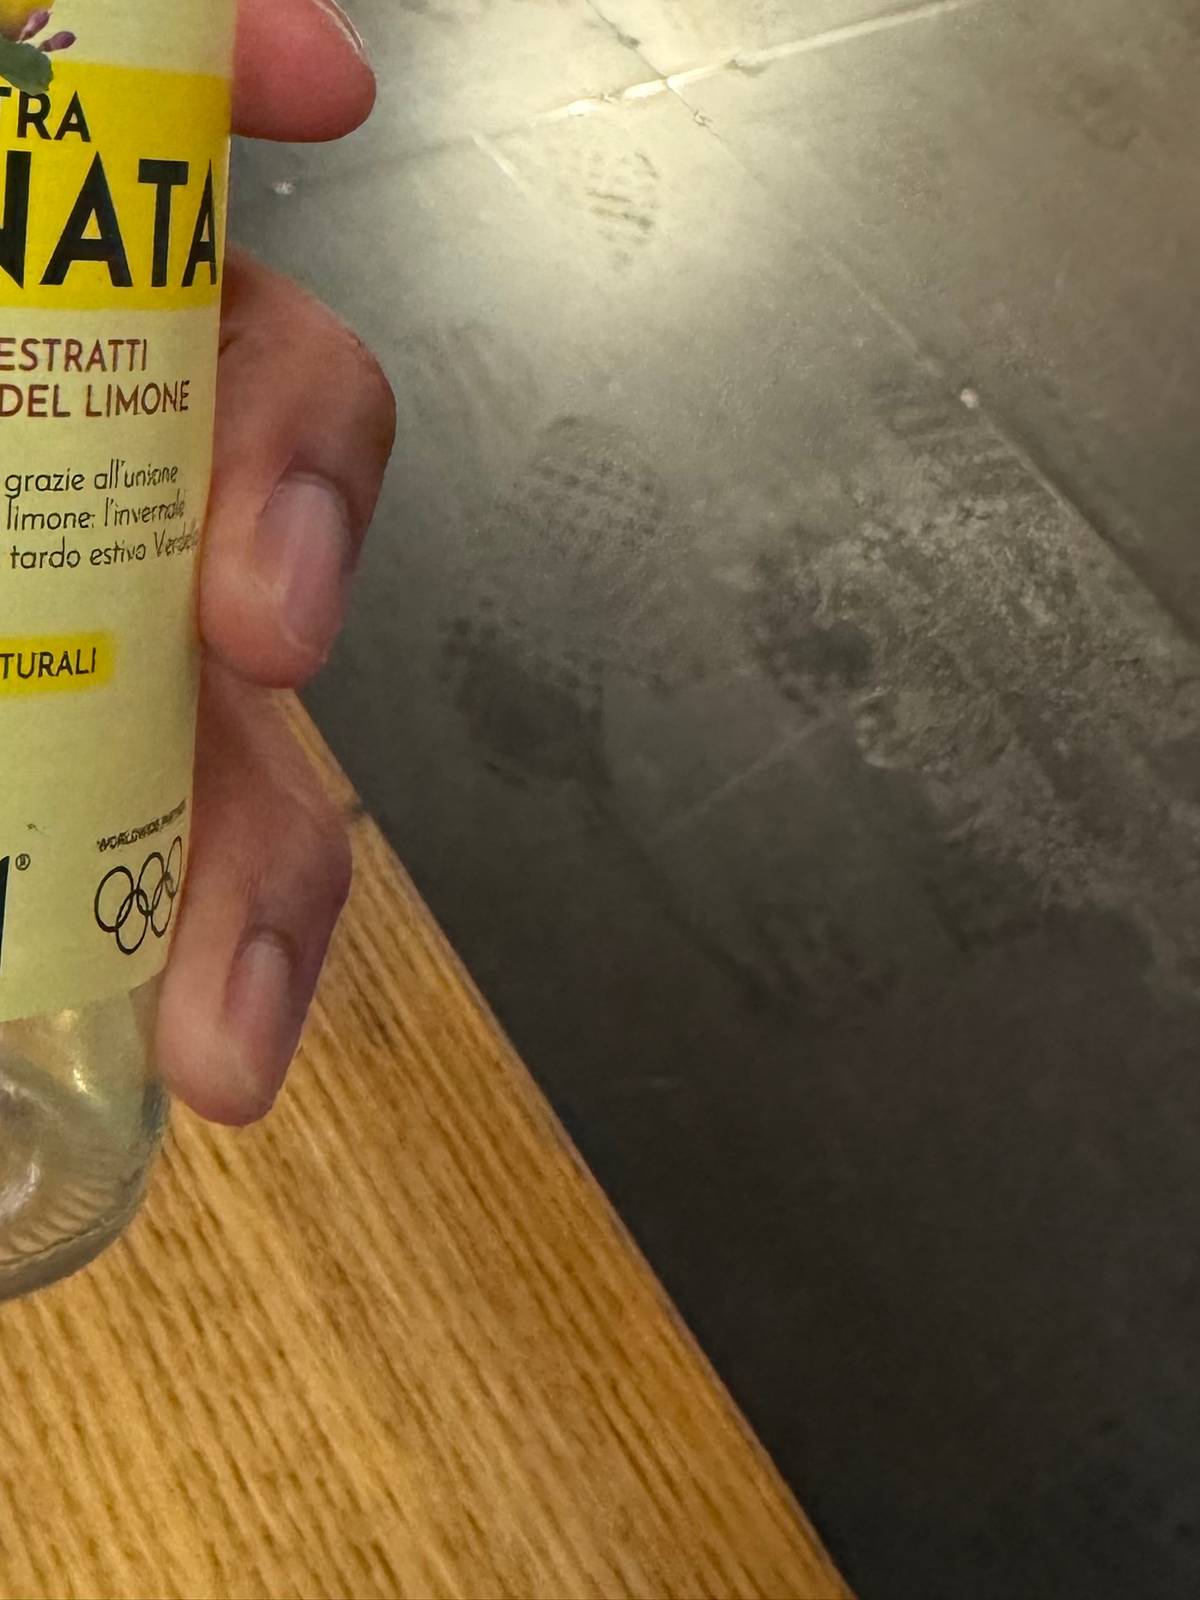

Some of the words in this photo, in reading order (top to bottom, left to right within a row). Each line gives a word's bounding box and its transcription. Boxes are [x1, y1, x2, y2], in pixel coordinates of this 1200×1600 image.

[85, 380, 191, 418] LIMONE
[4, 468, 85, 499] grazie
[94, 458, 179, 491] all'unione
[6, 498, 95, 531] limone:
[104, 489, 186, 528] l'invernale
[9, 536, 81, 570] tardo
[89, 539, 147, 566] estivo
